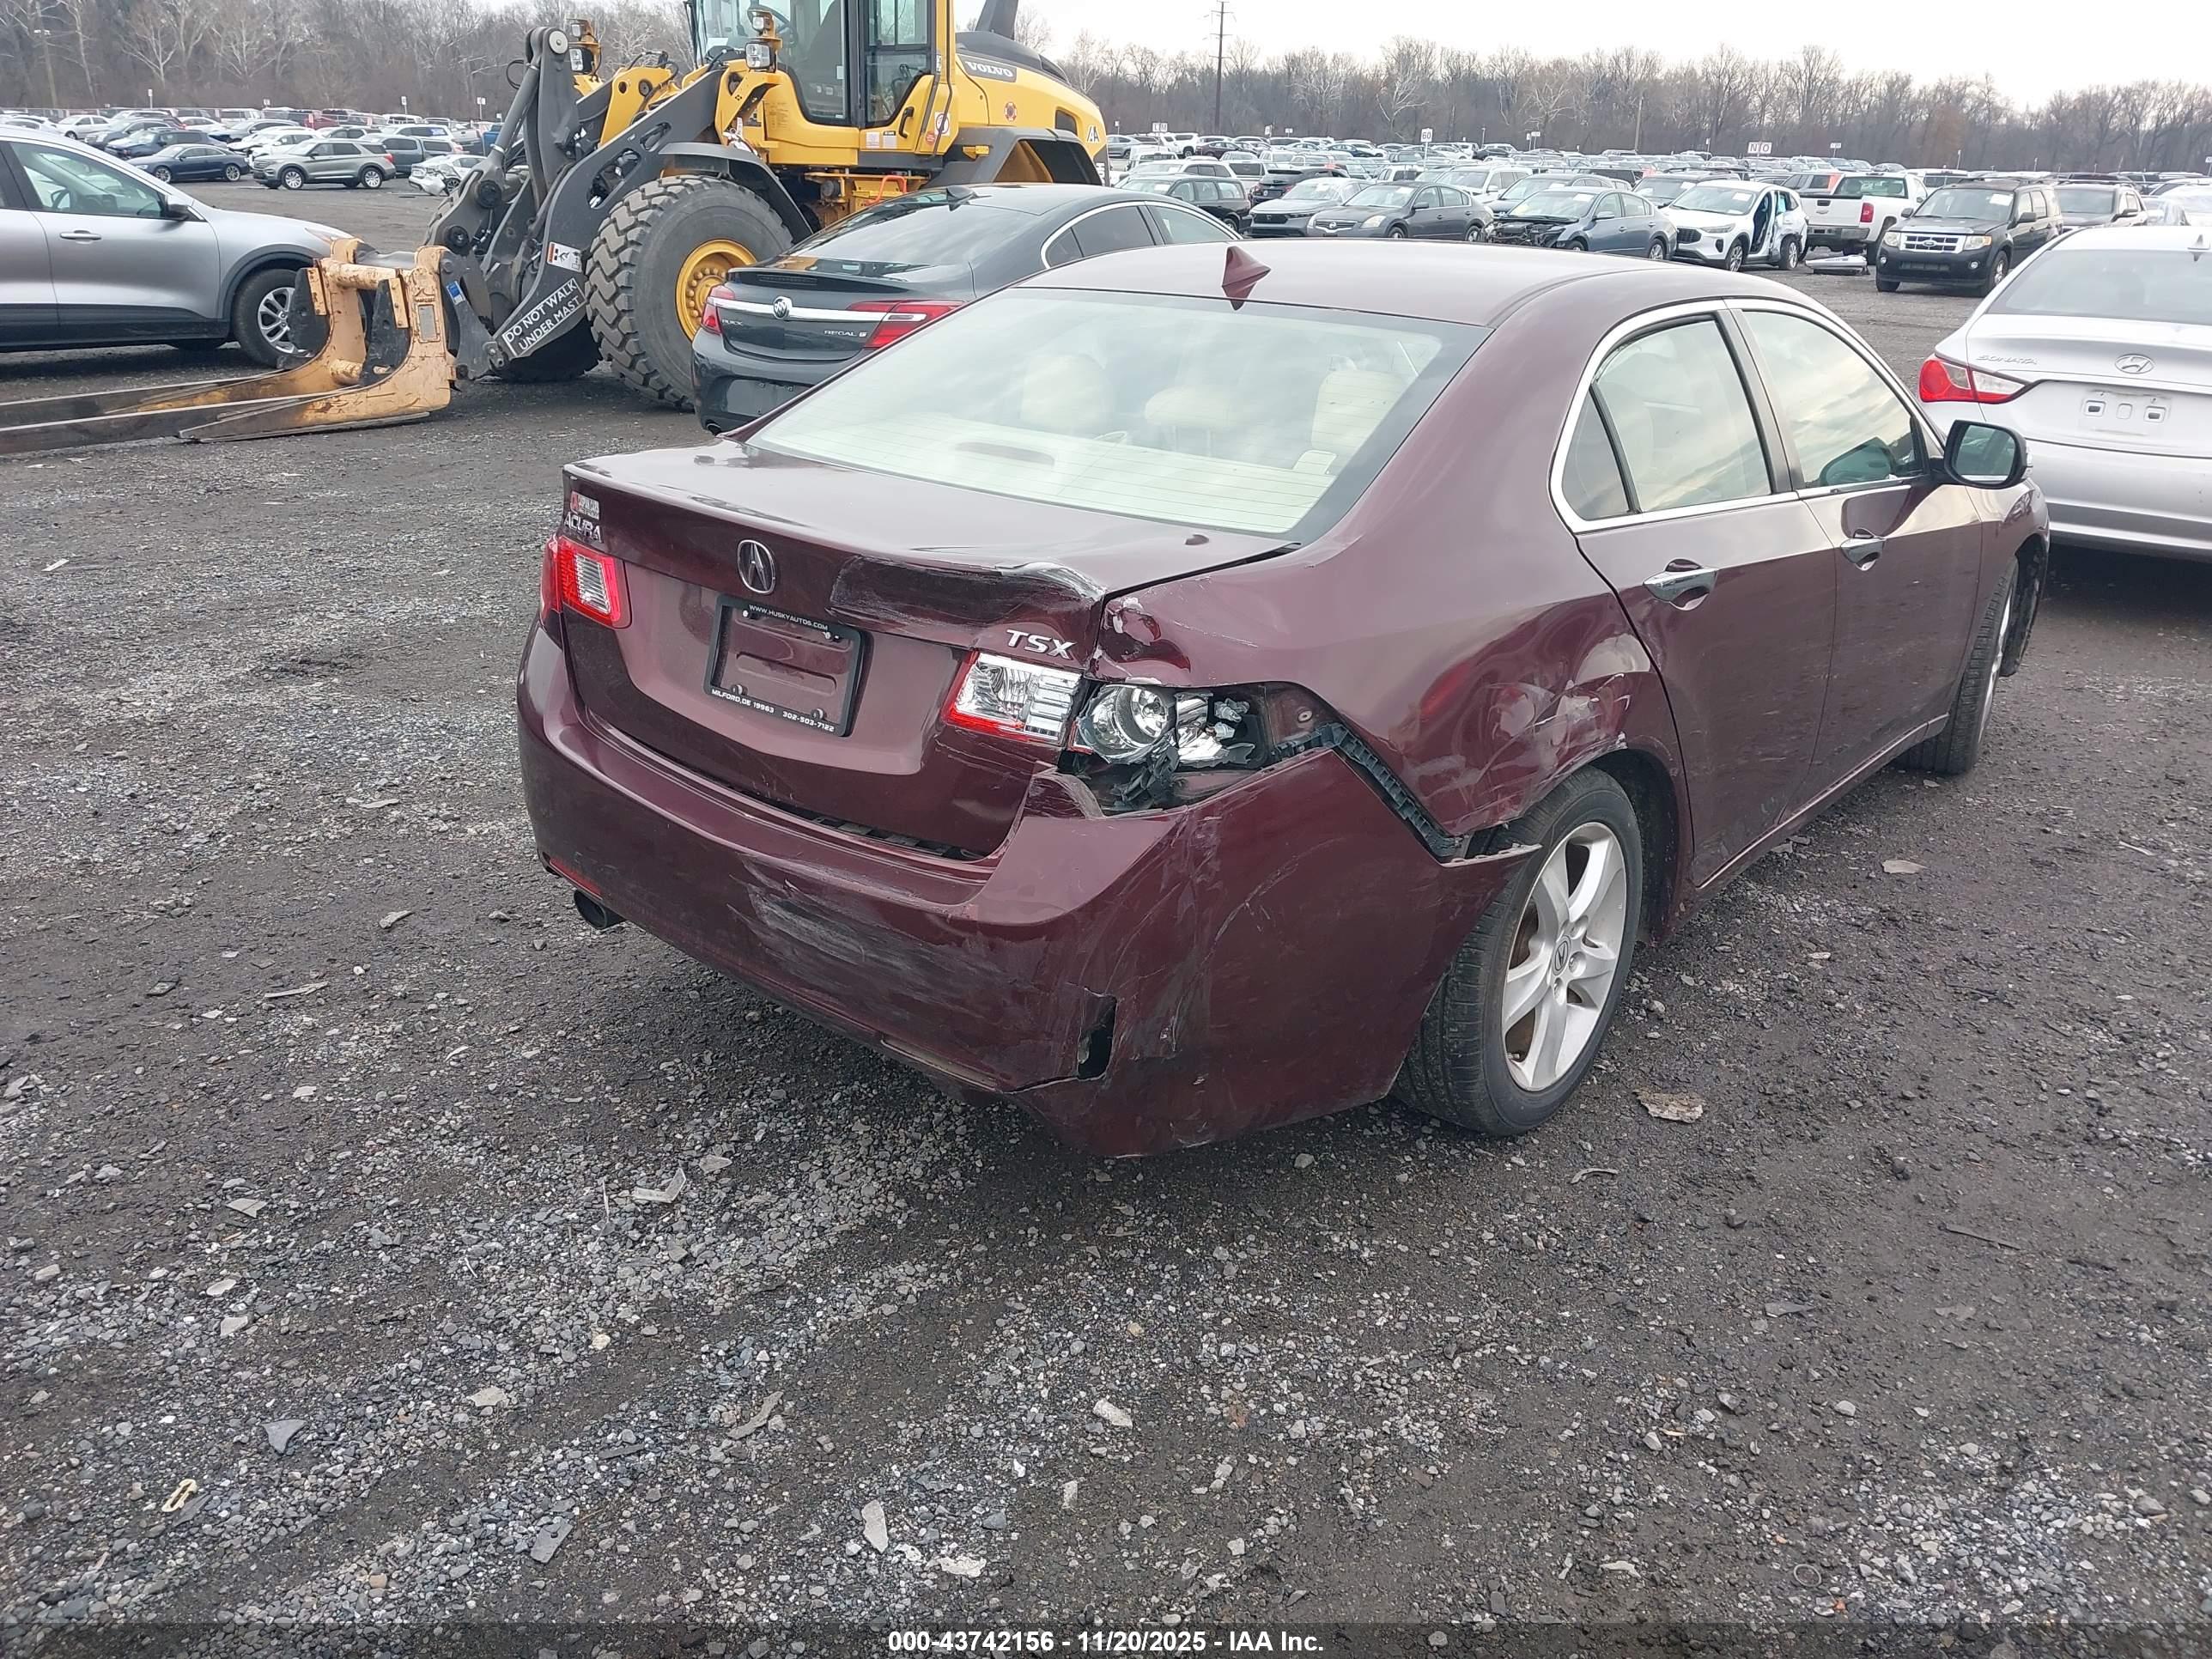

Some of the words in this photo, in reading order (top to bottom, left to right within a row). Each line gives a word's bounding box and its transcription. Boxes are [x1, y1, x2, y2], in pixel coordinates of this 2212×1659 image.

[965, 61, 1013, 77] VOLVO
[505, 325, 523, 343] DO
[522, 305, 546, 329] NOT
[544, 280, 577, 308] WALK
[518, 319, 555, 350] UNDER
[553, 295, 581, 323] MAST
[1975, 354, 2039, 365] SONATA
[563, 511, 603, 544] ACURA
[749, 604, 829, 631] WWW.HUSKYAUTOS.COM
[1006, 629, 1077, 660] TSX
[752, 702, 775, 714] 19963
[782, 710, 835, 732] 302-503-7122
